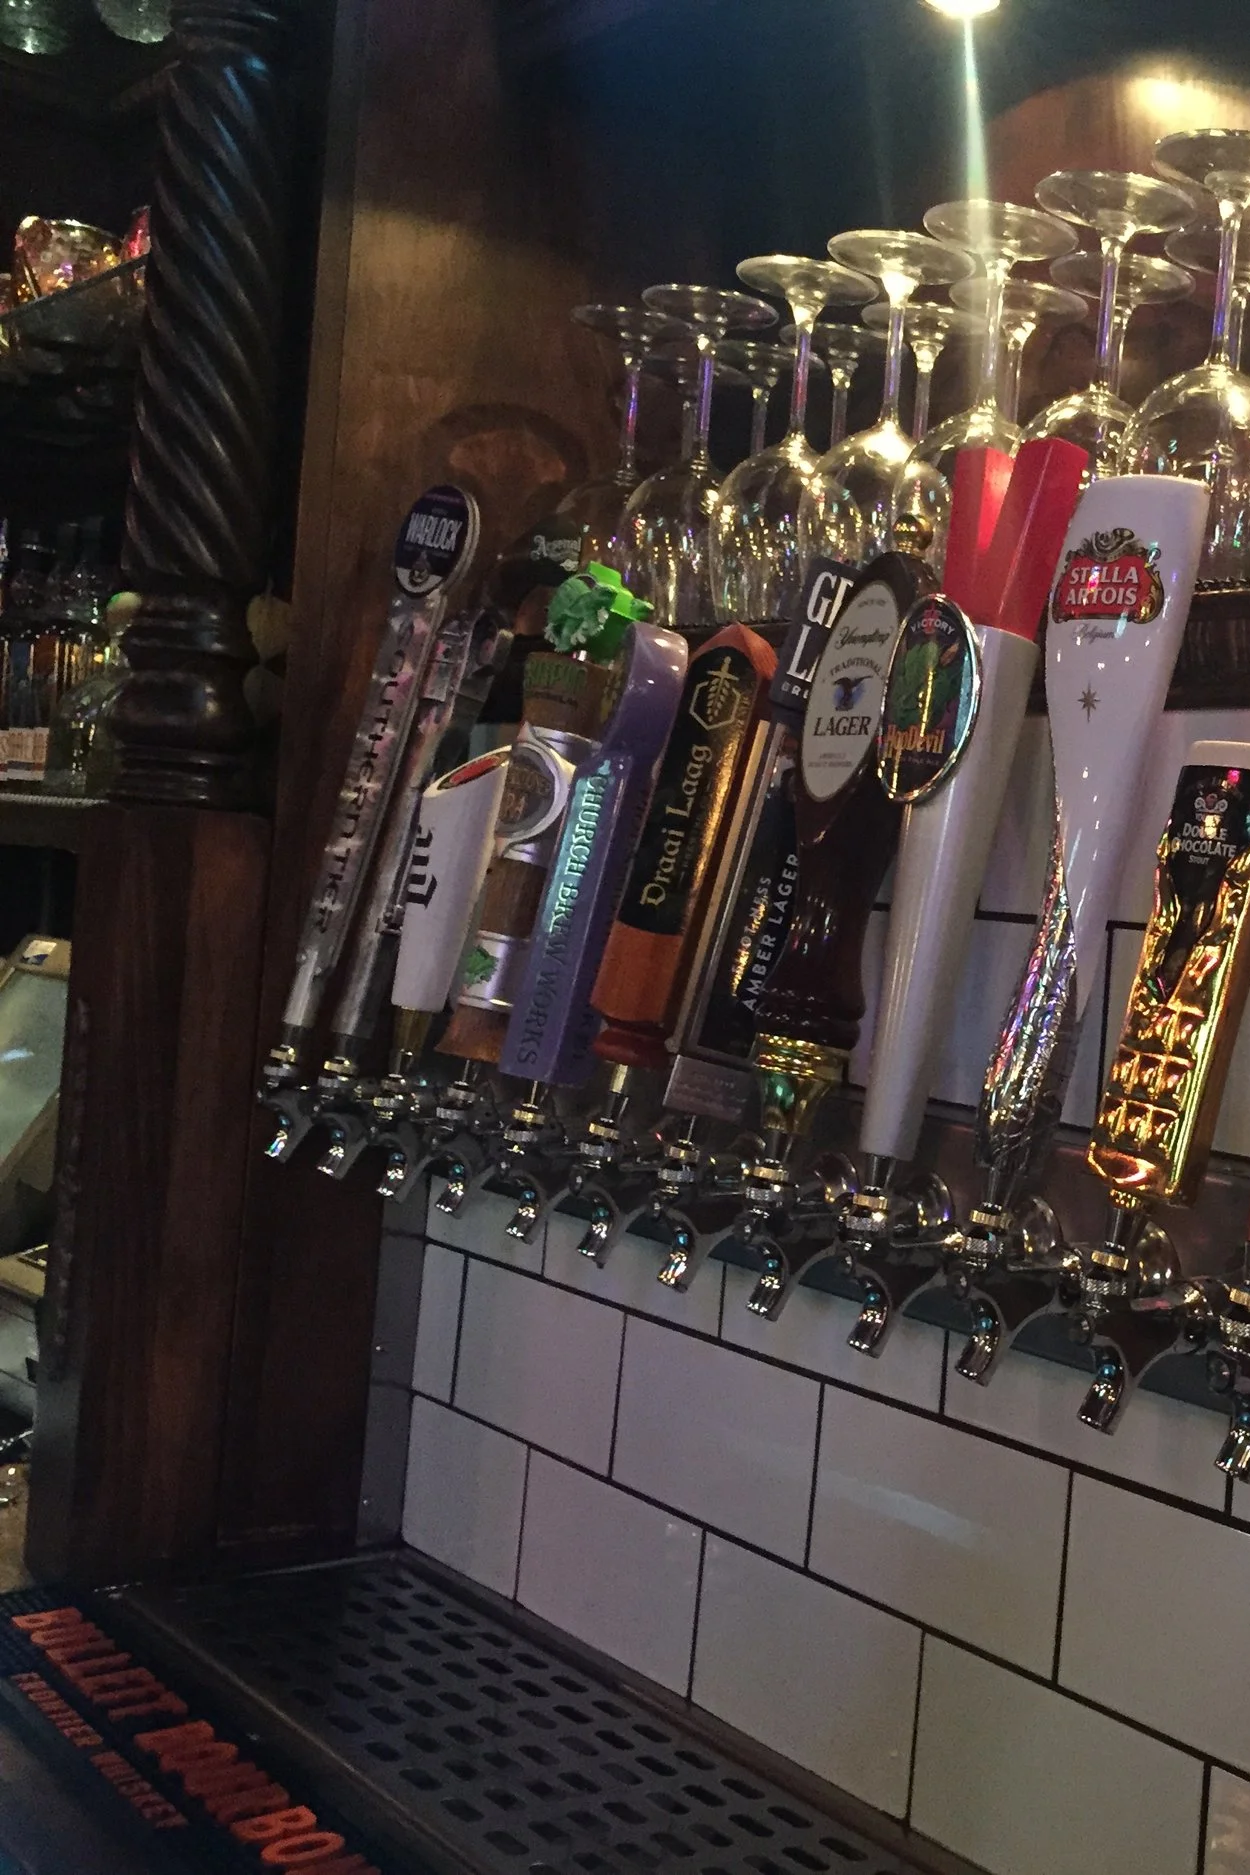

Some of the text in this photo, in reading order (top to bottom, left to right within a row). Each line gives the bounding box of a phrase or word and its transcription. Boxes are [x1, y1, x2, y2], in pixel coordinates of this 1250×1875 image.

[404, 511, 463, 552] WARLOCK
[1070, 566, 1138, 585] STLLA
[1066, 587, 1137, 605] ARTOIS
[911, 618, 955, 635] VICTORY
[830, 657, 881, 676] TRADITIONAL
[813, 716, 872, 736] LAGER
[640, 827, 686, 906] Draai
[665, 744, 714, 817] Laag
[1182, 822, 1227, 841] DOLE
[1172, 836, 1236, 858] CHOCOLATE
[517, 773, 608, 1066] CHURCH BREW WORKS
[742, 853, 800, 1011] AMBER LAGER
